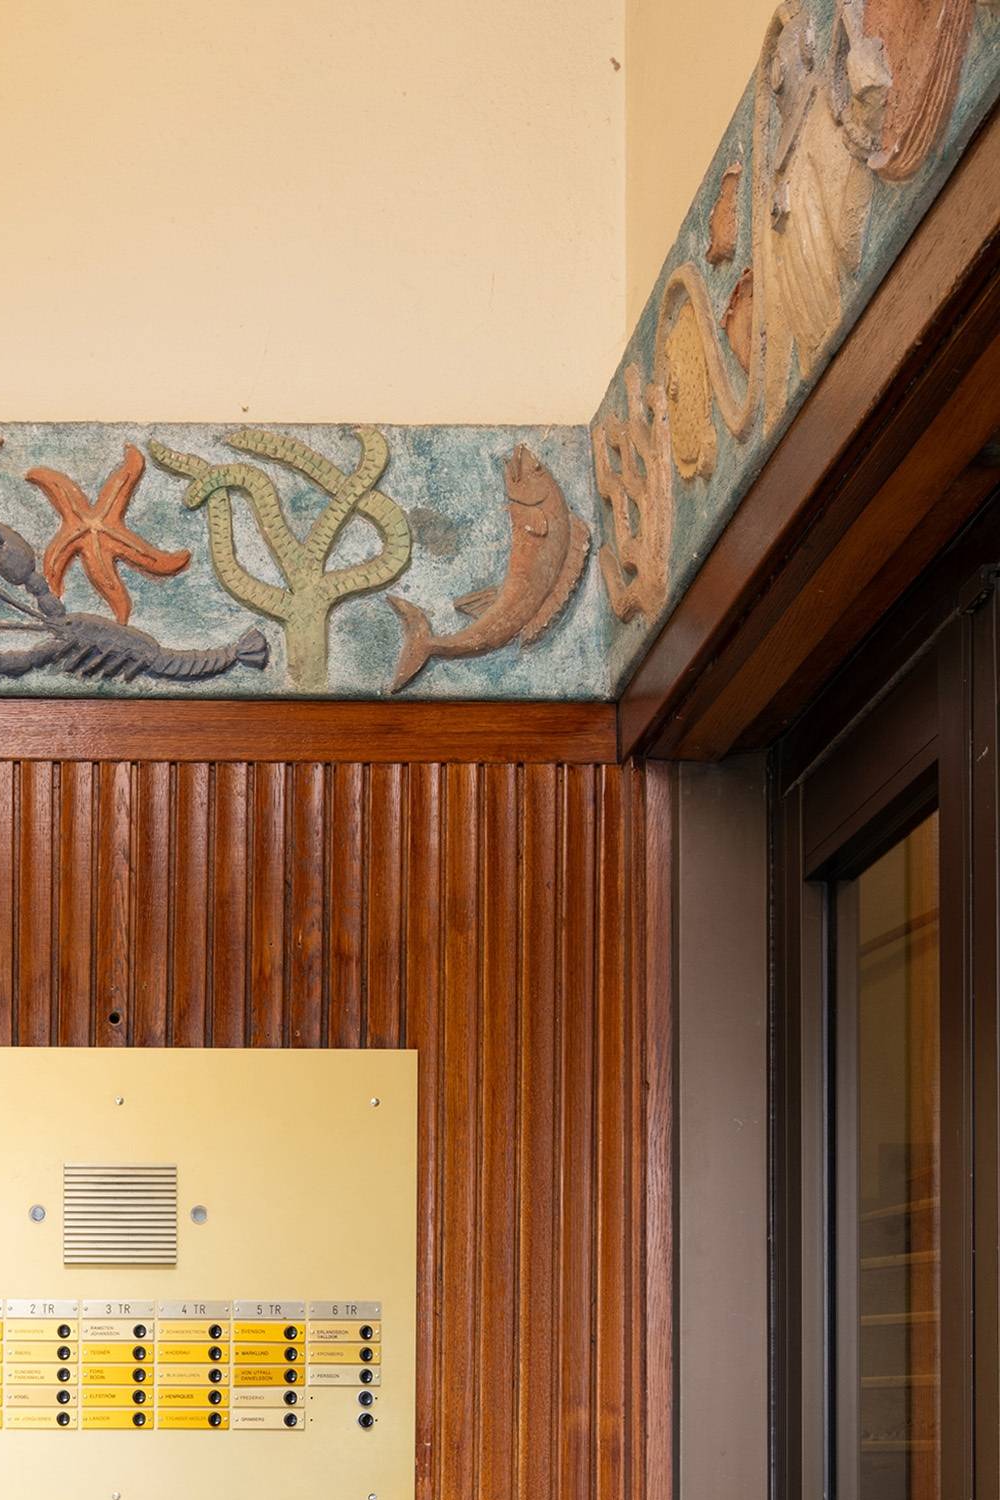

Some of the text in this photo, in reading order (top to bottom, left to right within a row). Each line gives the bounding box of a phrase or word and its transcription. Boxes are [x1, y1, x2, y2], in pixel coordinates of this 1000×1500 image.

[30, 1304, 55, 1314] 2 TR
[106, 1304, 132, 1314] 3 TR
[181, 1305, 206, 1315] 4 TR
[257, 1305, 282, 1315] 5 TR
[332, 1305, 358, 1315] 6 TR
